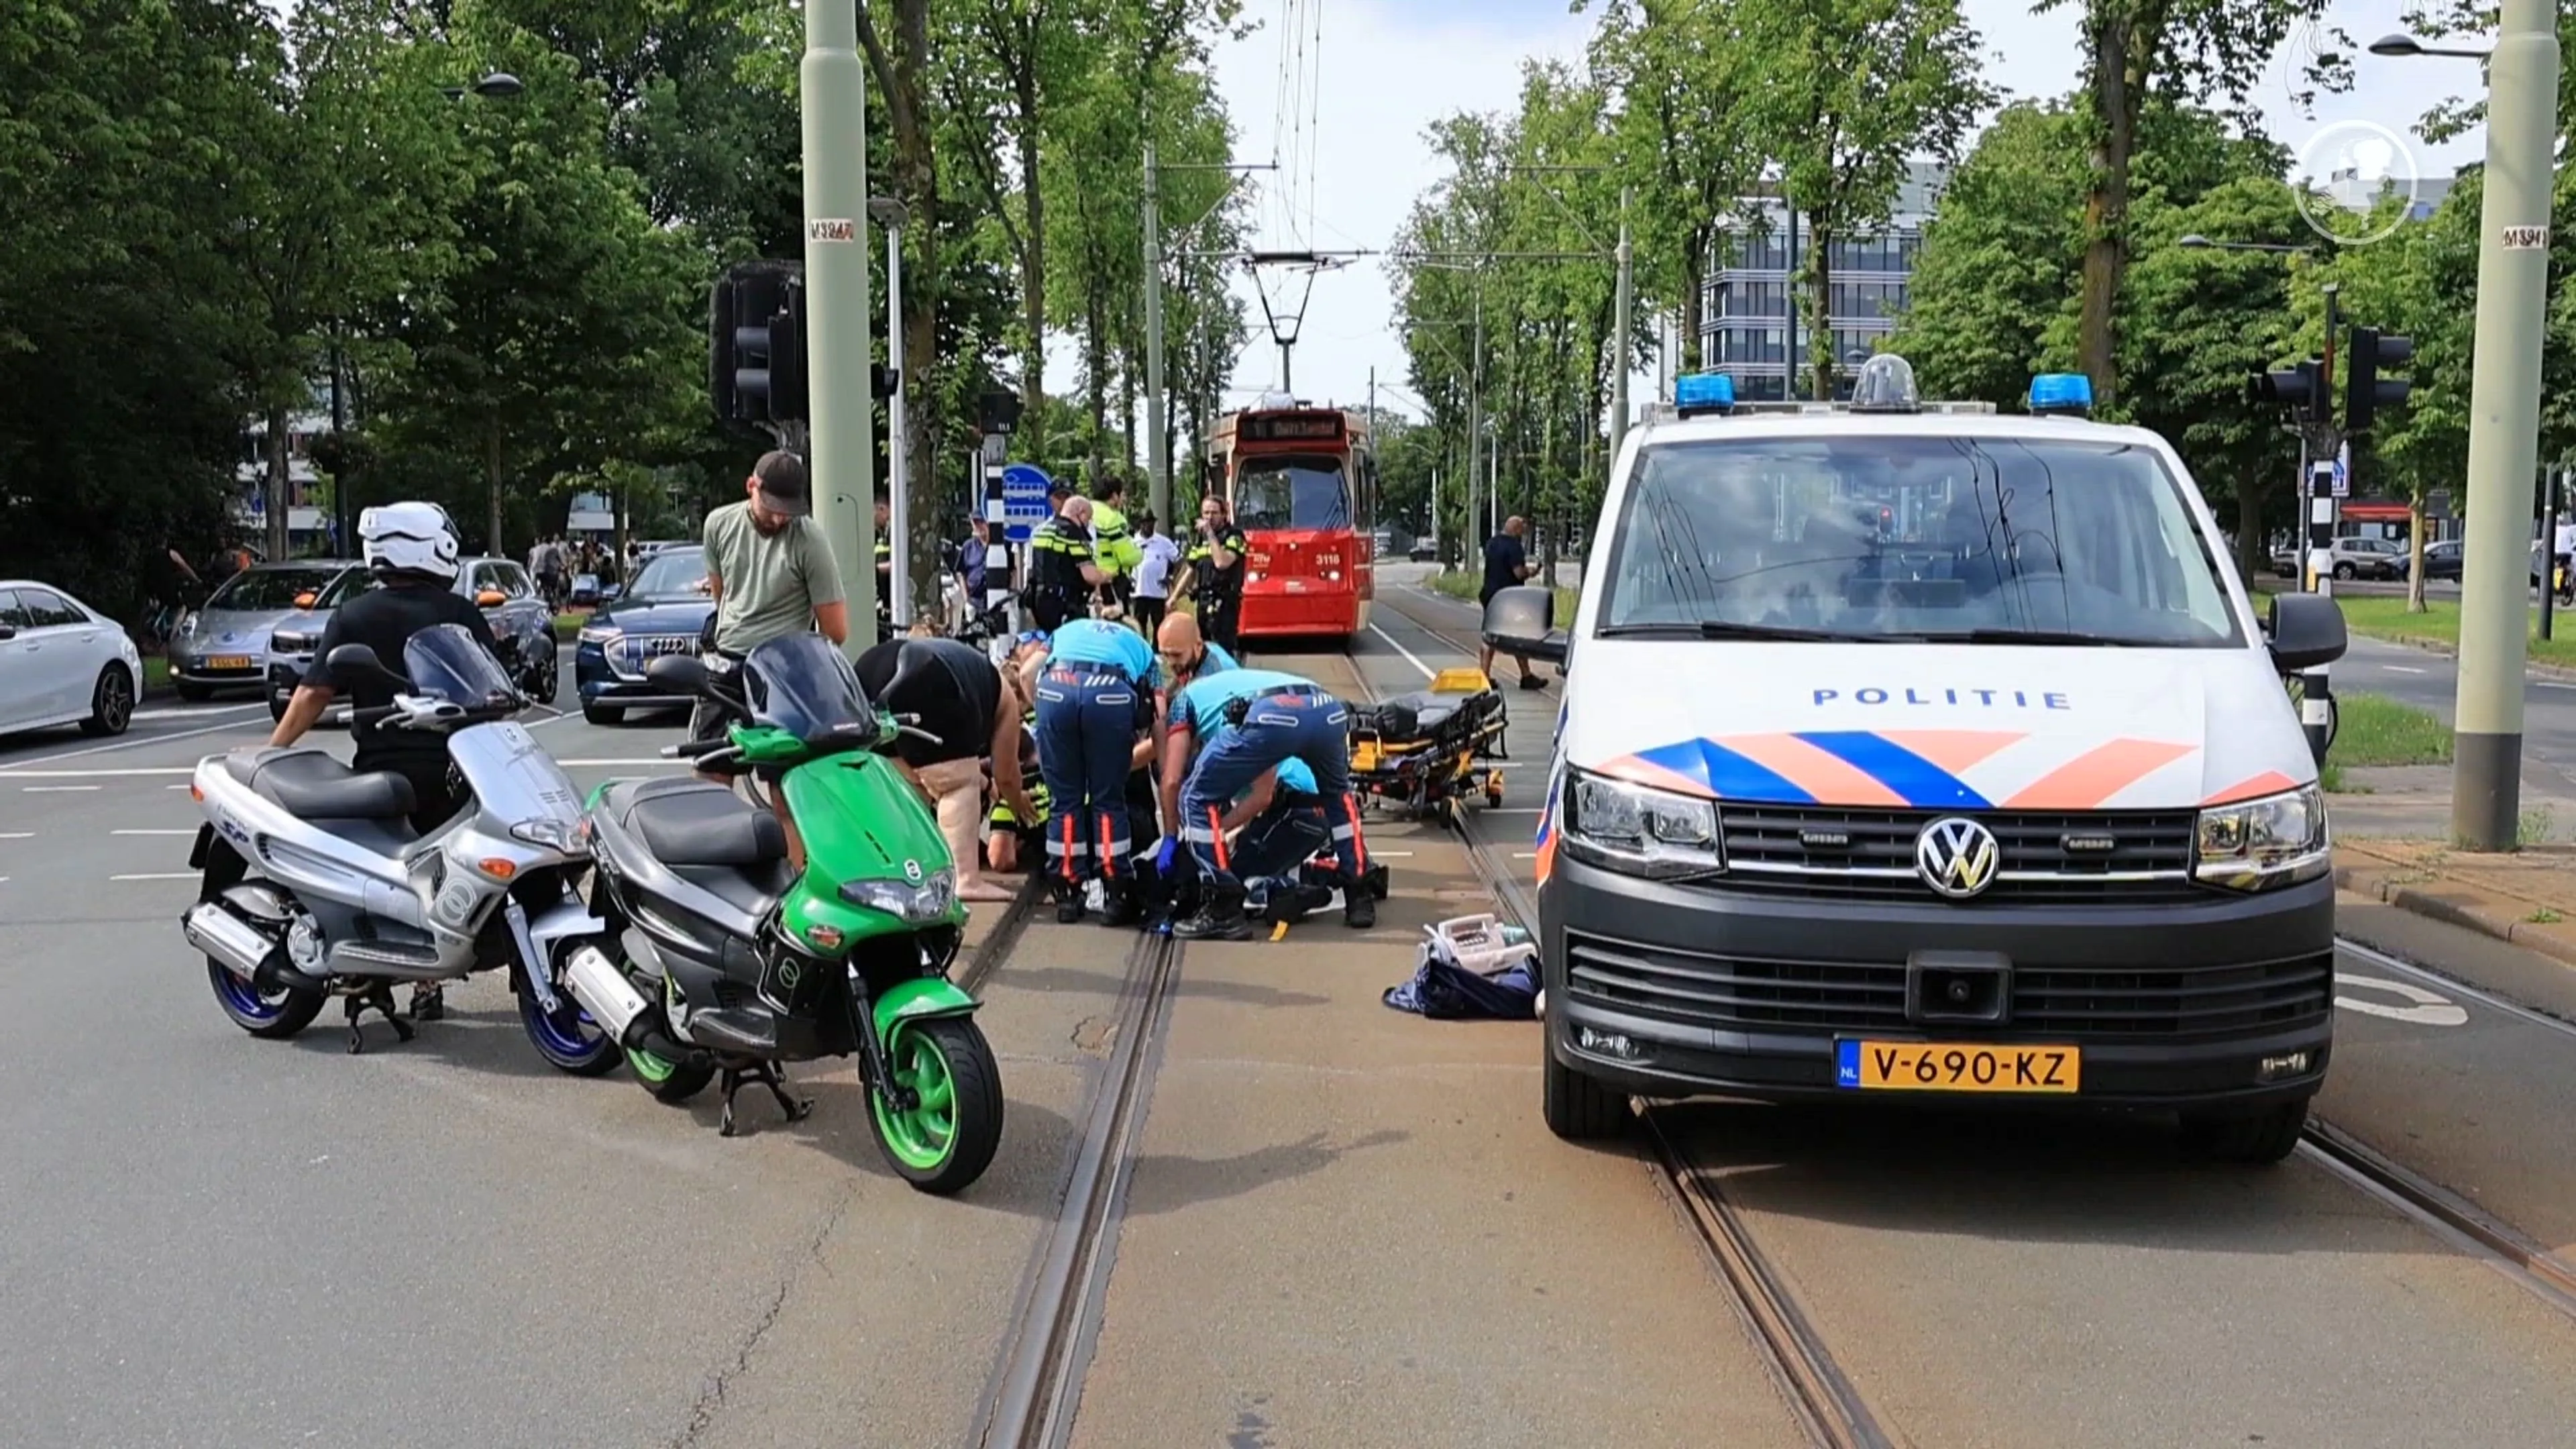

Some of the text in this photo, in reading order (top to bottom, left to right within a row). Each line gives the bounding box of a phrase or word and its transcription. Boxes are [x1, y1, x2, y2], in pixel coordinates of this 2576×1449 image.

[1813, 688, 2072, 710] POLITIE
[1841, 1067, 1857, 1079] NL
[1874, 1048, 2065, 1085] V-690-KZ
